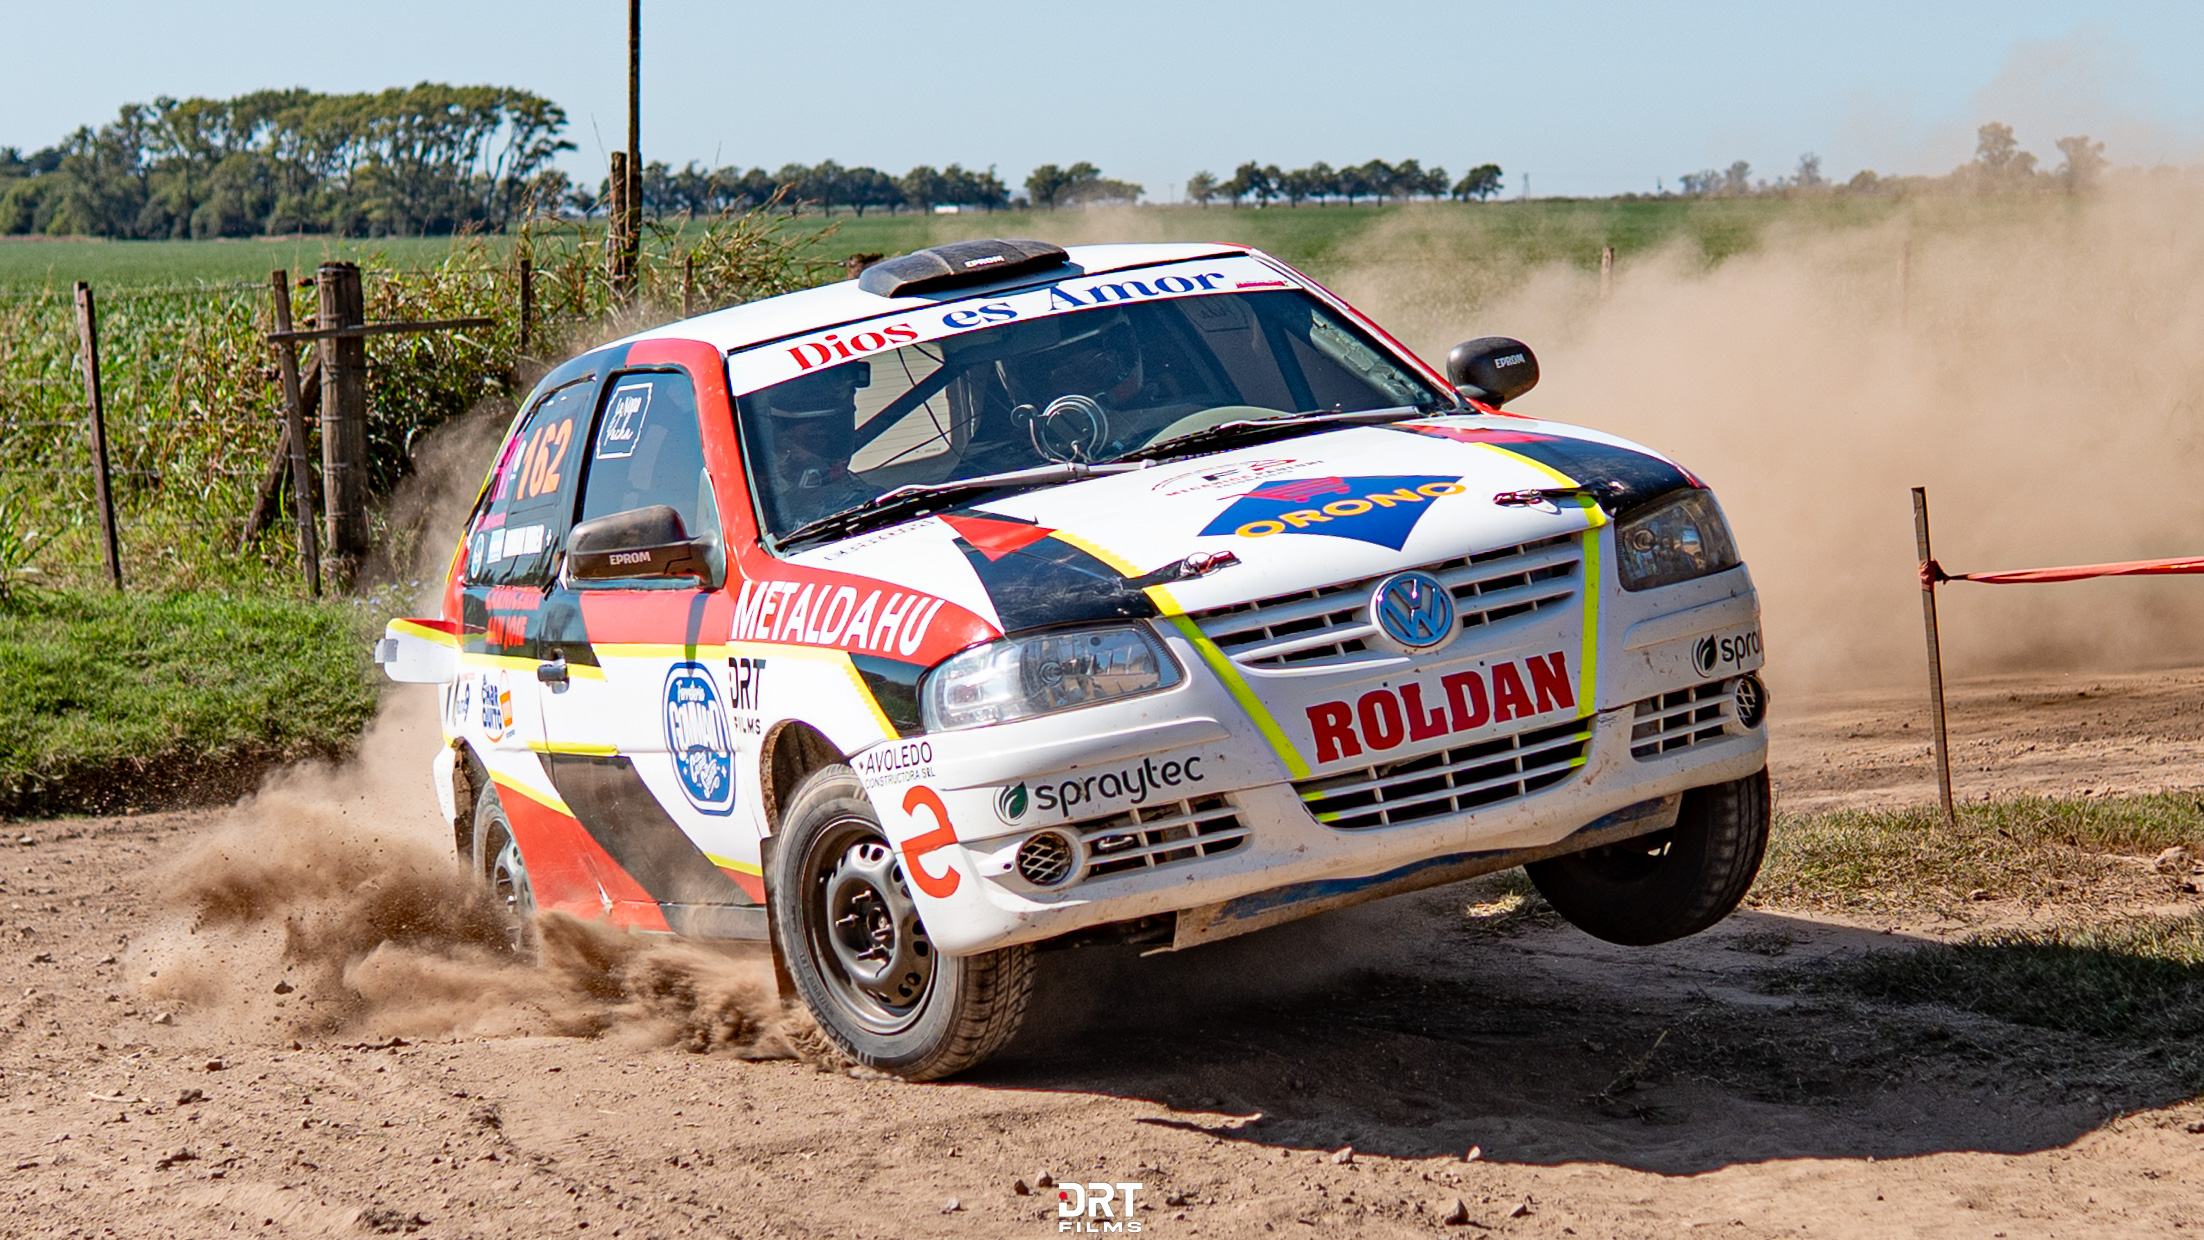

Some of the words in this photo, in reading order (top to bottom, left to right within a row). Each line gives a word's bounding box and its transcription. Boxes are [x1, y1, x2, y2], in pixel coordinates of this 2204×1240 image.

[785, 323, 920, 372] Dios
[942, 303, 1018, 329] es
[1048, 270, 1225, 312] Amor
[1494, 353, 1525, 369] EPROM
[516, 418, 573, 500] 162
[1235, 482, 1467, 538] ORONO
[609, 551, 651, 566] EPROM
[731, 580, 945, 656] METALDAHU
[728, 656, 766, 711] DRT
[1305, 651, 1575, 764] ROLDAN
[733, 716, 761, 735] FILMS
[864, 770, 920, 789] CONSTRUCTORA
[921, 766, 936, 779] SRL
[865, 741, 933, 776] AVOLEDO
[1034, 756, 1205, 817] spraytec
